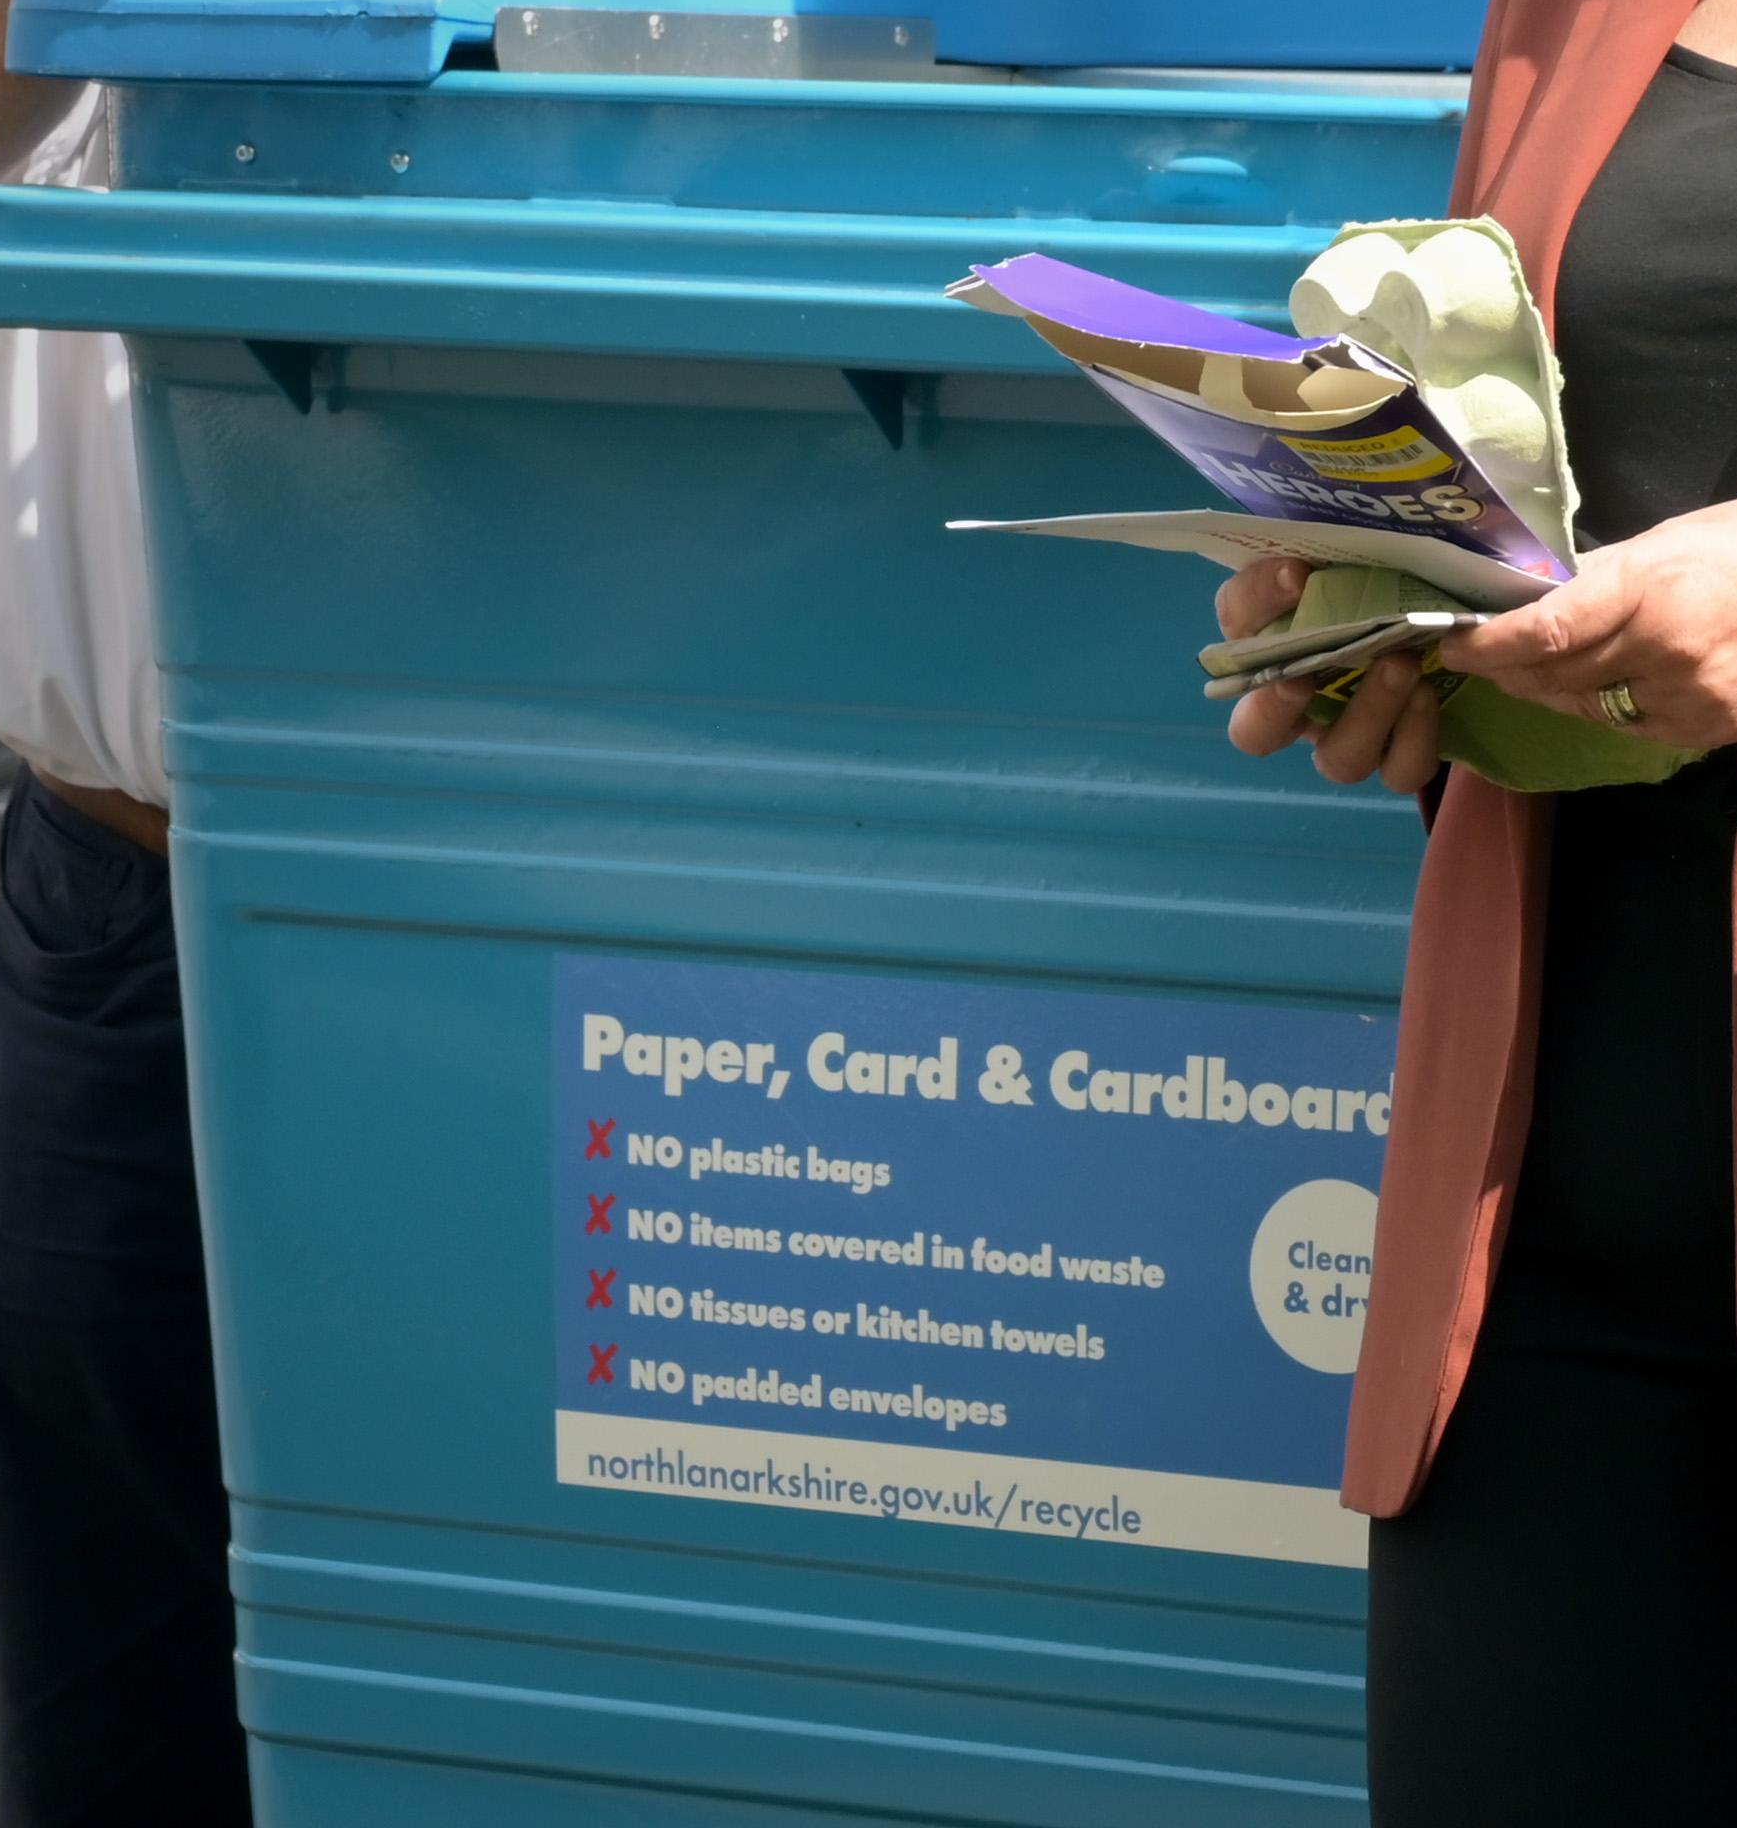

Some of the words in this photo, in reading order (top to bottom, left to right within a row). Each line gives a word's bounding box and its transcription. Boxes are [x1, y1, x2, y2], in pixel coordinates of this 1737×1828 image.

[1299, 440, 1384, 453] REDUCED
[1202, 452, 1486, 523] HEROES
[584, 1014, 790, 1099] Paper,
[807, 1032, 958, 1100] Card
[979, 1045, 1033, 1105] &
[628, 1134, 683, 1168] NO
[690, 1138, 800, 1180] plastic
[807, 1146, 890, 1194] bags
[629, 1209, 683, 1243] NO
[691, 1211, 782, 1253] items
[788, 1232, 924, 1266] covered
[932, 1235, 964, 1269] in
[971, 1238, 1052, 1277] food
[1059, 1256, 1165, 1288] waste
[1288, 1241, 1372, 1275] Clean
[629, 1284, 683, 1318] NO
[690, 1289, 806, 1330] tissues
[813, 1311, 850, 1334] or
[857, 1303, 983, 1348] kitchen
[990, 1320, 1104, 1360] towels
[1283, 1281, 1311, 1316] &
[631, 1359, 685, 1393] NO
[693, 1368, 822, 1407] padded
[829, 1385, 1006, 1431] envelopes
[587, 1446, 1143, 1541] northlanarkshire.gov.uk/recycle
